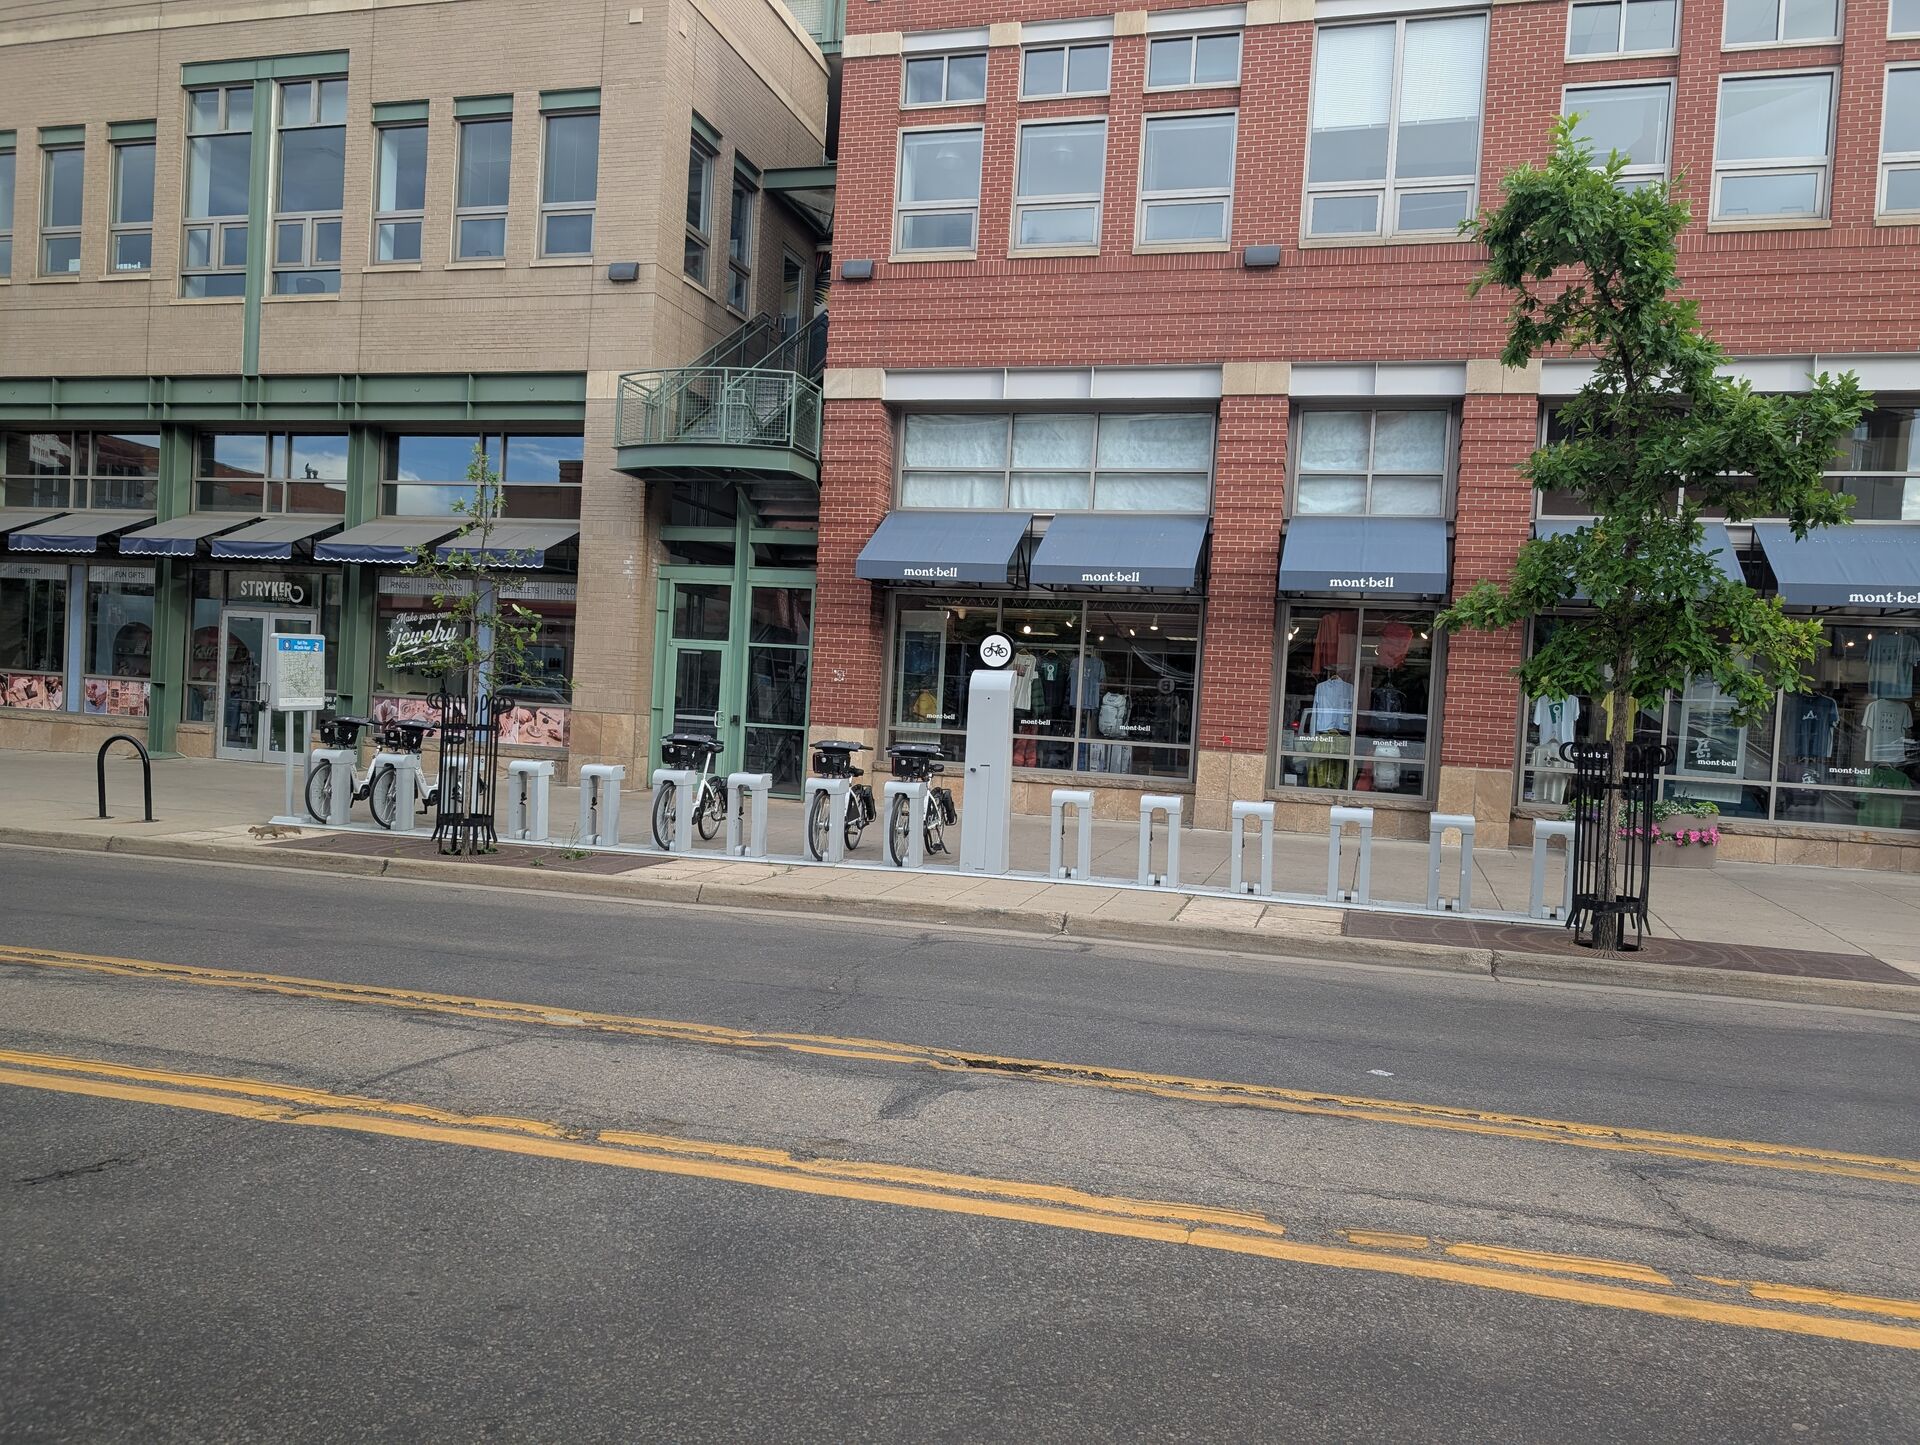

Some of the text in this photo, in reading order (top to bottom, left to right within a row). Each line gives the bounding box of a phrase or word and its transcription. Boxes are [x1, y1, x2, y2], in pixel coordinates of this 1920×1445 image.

[114, 569, 145, 579] FUN GIFTS
[390, 581, 410, 589] RINGS
[240, 580, 304, 603] STRYKER
[396, 612, 418, 624] Make
[418, 612, 436, 624] your
[389, 620, 458, 656] jewelry
